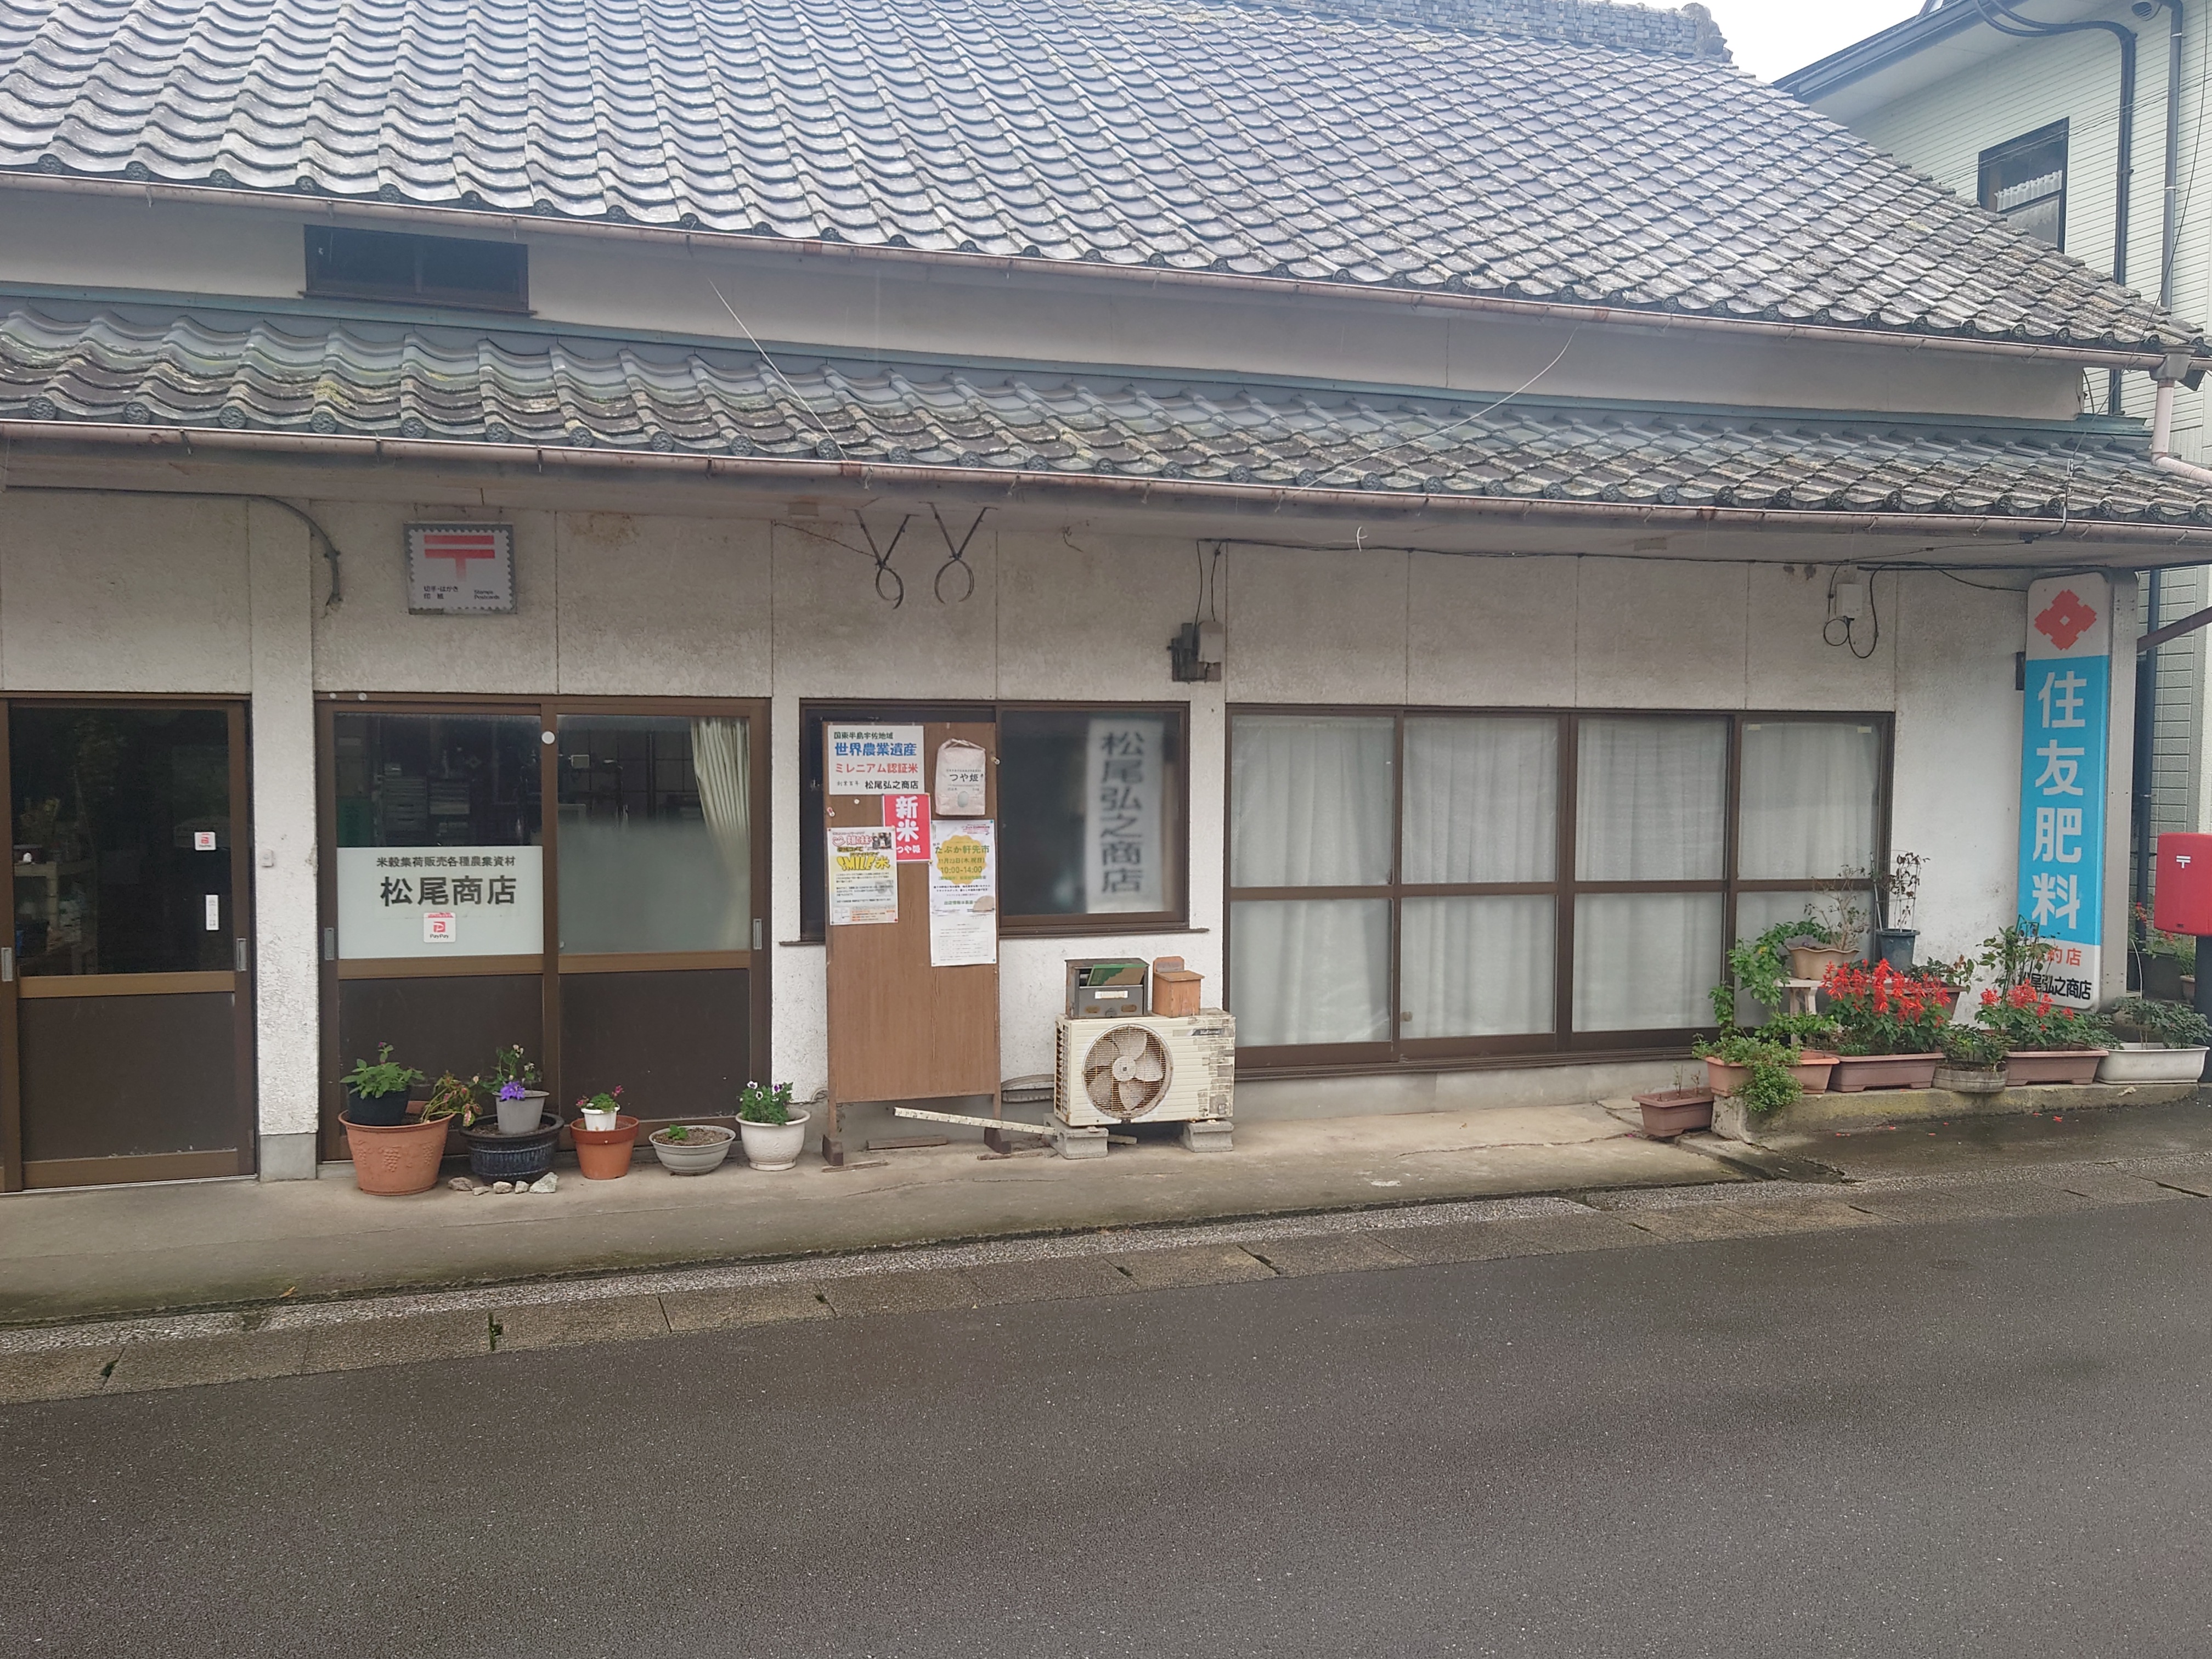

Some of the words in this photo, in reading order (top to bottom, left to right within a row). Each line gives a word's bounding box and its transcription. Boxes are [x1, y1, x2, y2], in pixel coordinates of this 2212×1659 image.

[835, 742, 917, 756] 世界農業遺産
[836, 763, 918, 774] ミレニアム認証米
[950, 773, 979, 782] つや姫
[865, 780, 919, 789] 松尾弘之商店
[2032, 671, 2087, 929] 住友肥料
[895, 795, 919, 842] 新米
[1100, 731, 1144, 893] 松尾弘之商店
[896, 845, 921, 854] つや姫
[935, 845, 990, 854] たぶか軒先市
[376, 855, 516, 868] 米穀集荷販売各種農業資材
[380, 875, 517, 907] 松尾商店
